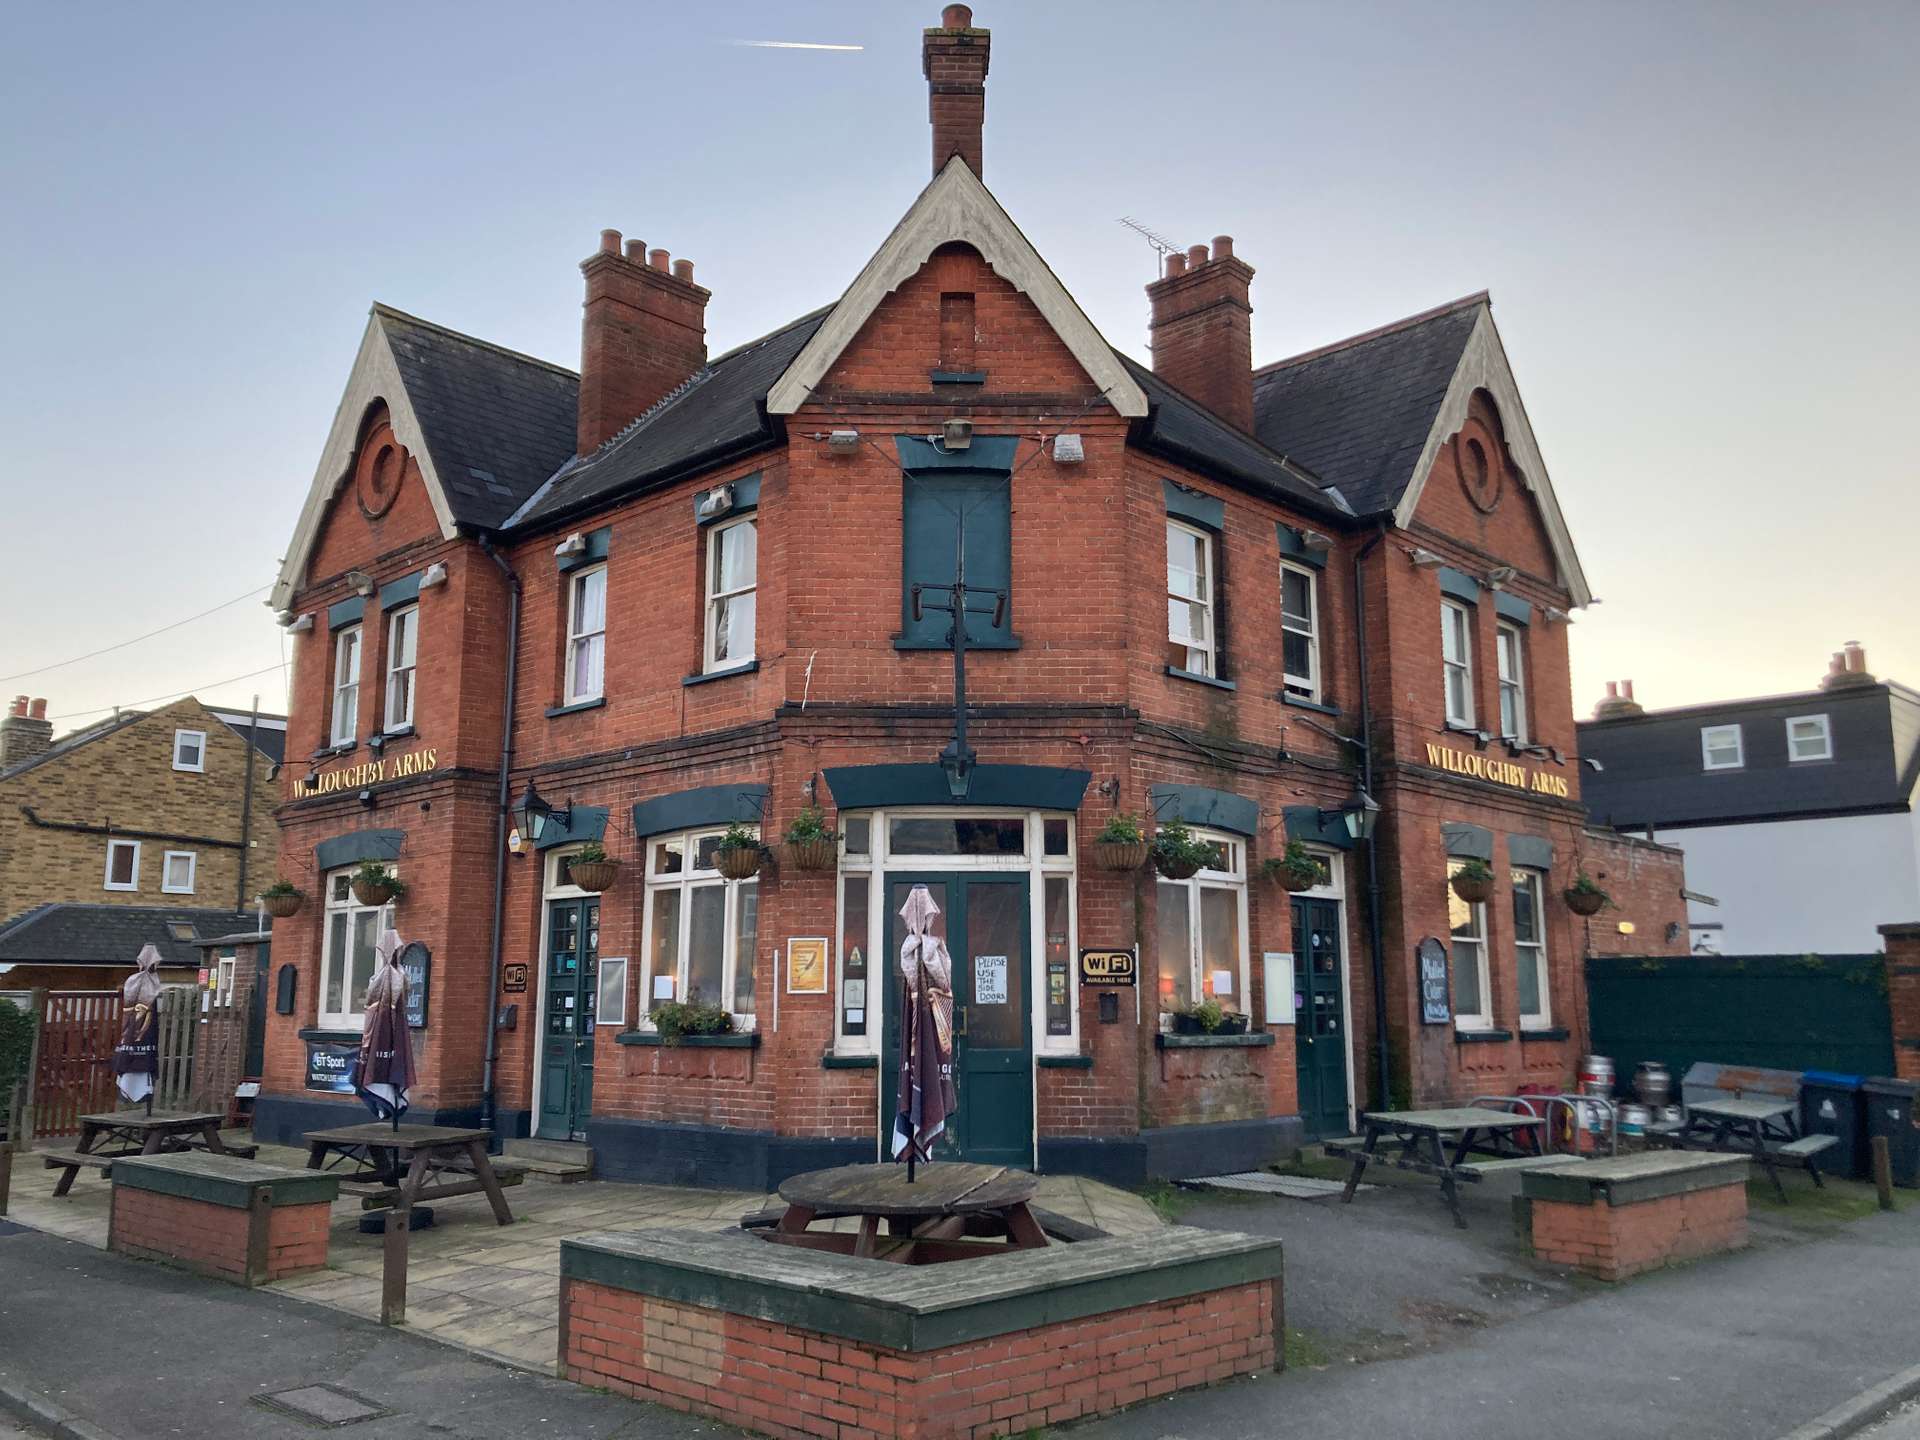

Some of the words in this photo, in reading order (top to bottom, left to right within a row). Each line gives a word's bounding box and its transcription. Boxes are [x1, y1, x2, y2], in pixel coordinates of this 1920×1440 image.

[294, 759, 386, 799] WLOUGHBY
[392, 748, 437, 778] ARMS
[1426, 743, 1526, 788] WILLOUGHBY
[1531, 771, 1568, 798] ARMS
[978, 957, 1005, 968] PLEASE
[977, 969, 996, 977] USE
[978, 984, 996, 992] SIDE
[316, 1056, 327, 1067] BT
[327, 1055, 345, 1069] Sport
[311, 1073, 328, 1081] WATCH
